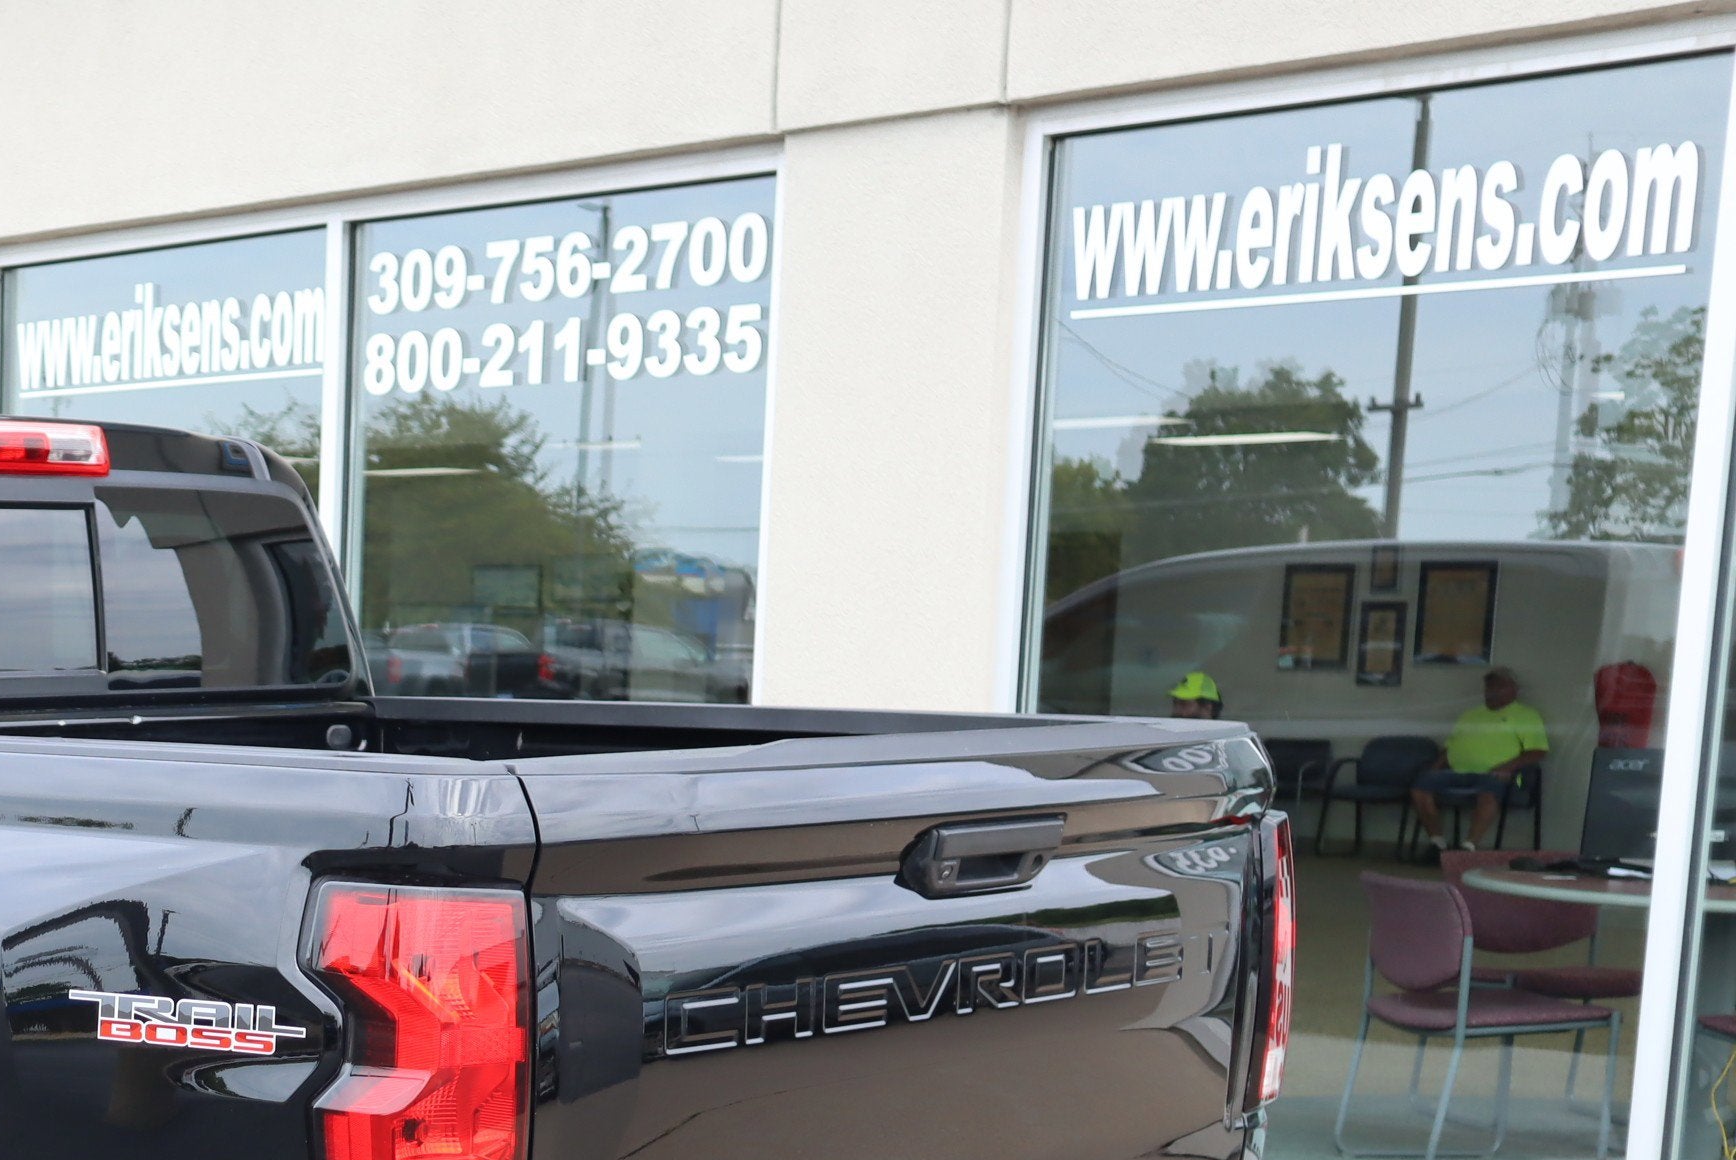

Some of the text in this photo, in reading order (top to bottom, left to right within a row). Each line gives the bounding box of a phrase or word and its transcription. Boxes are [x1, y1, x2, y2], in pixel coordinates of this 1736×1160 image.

[367, 211, 769, 316] 309-756-2700
[1073, 140, 1700, 301] www.eriksens.com
[16, 283, 325, 390] www.eriksens.com
[362, 303, 762, 396] 800-211-9335
[68, 989, 307, 1039] TRAIL
[97, 1018, 276, 1055] BOSS
[664, 920, 1231, 1057] CHEVROLET
